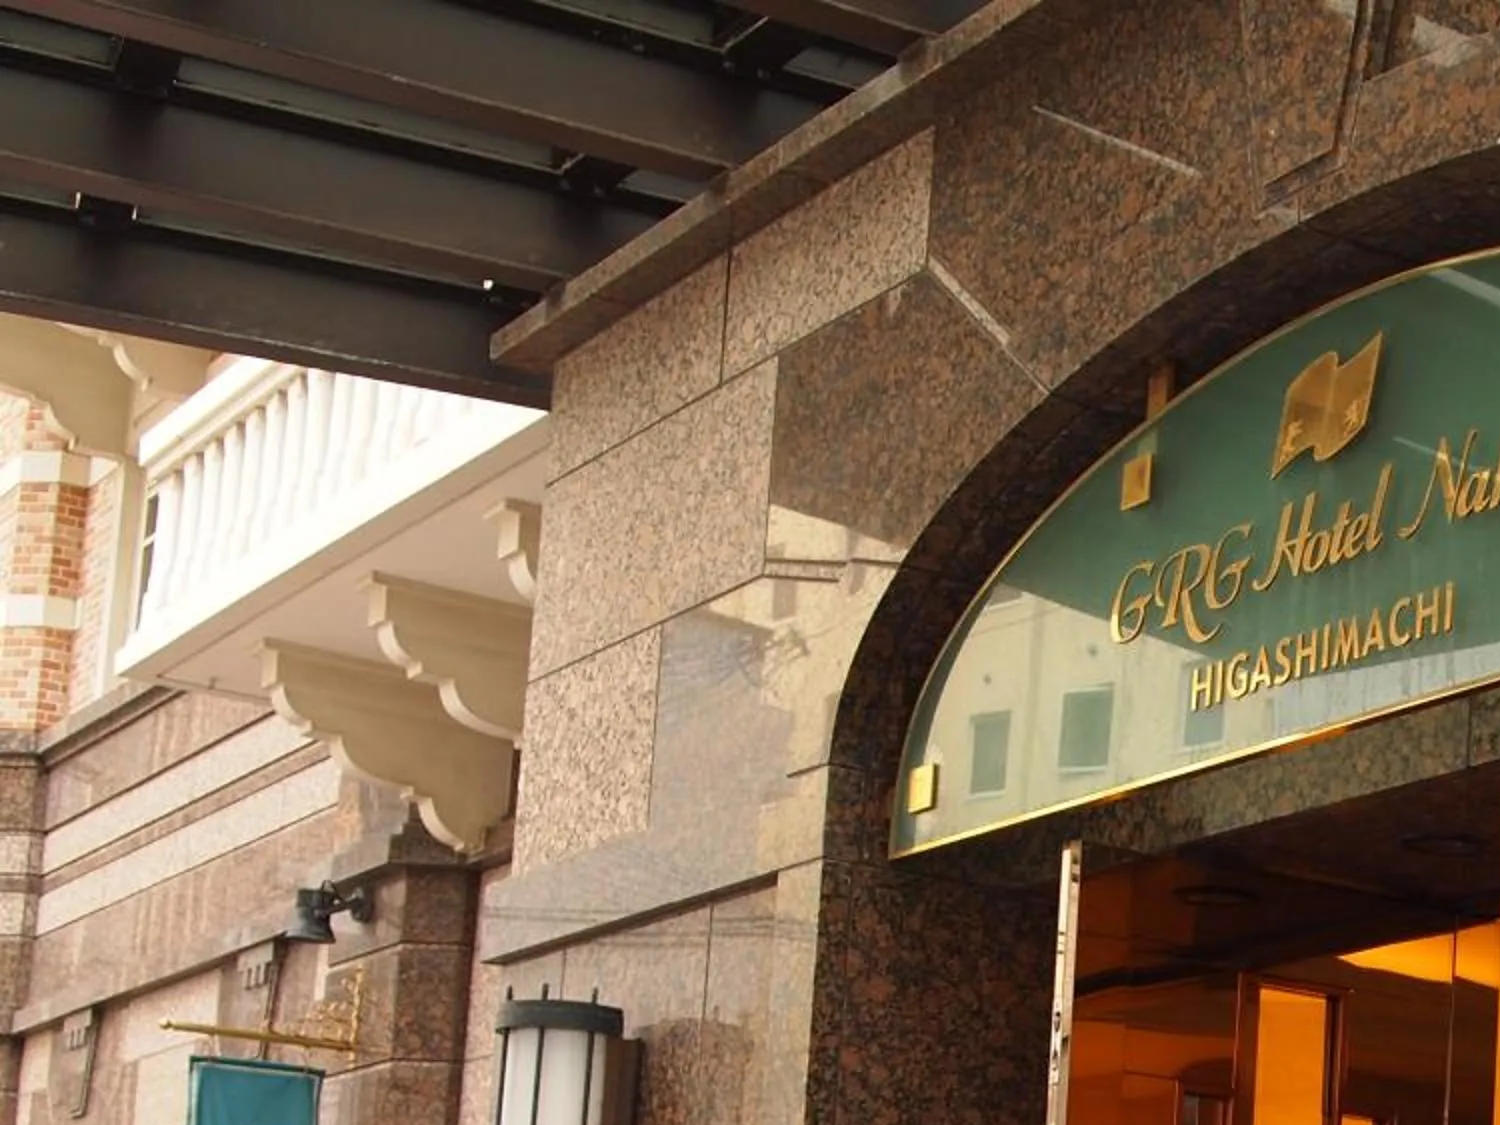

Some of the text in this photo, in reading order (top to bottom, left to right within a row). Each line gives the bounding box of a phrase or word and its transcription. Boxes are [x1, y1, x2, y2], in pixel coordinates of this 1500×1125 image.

[1110, 521, 1257, 645] GRG
[1252, 461, 1395, 593] Hotel
[1190, 580, 1456, 712] HIGASHIMACHI
